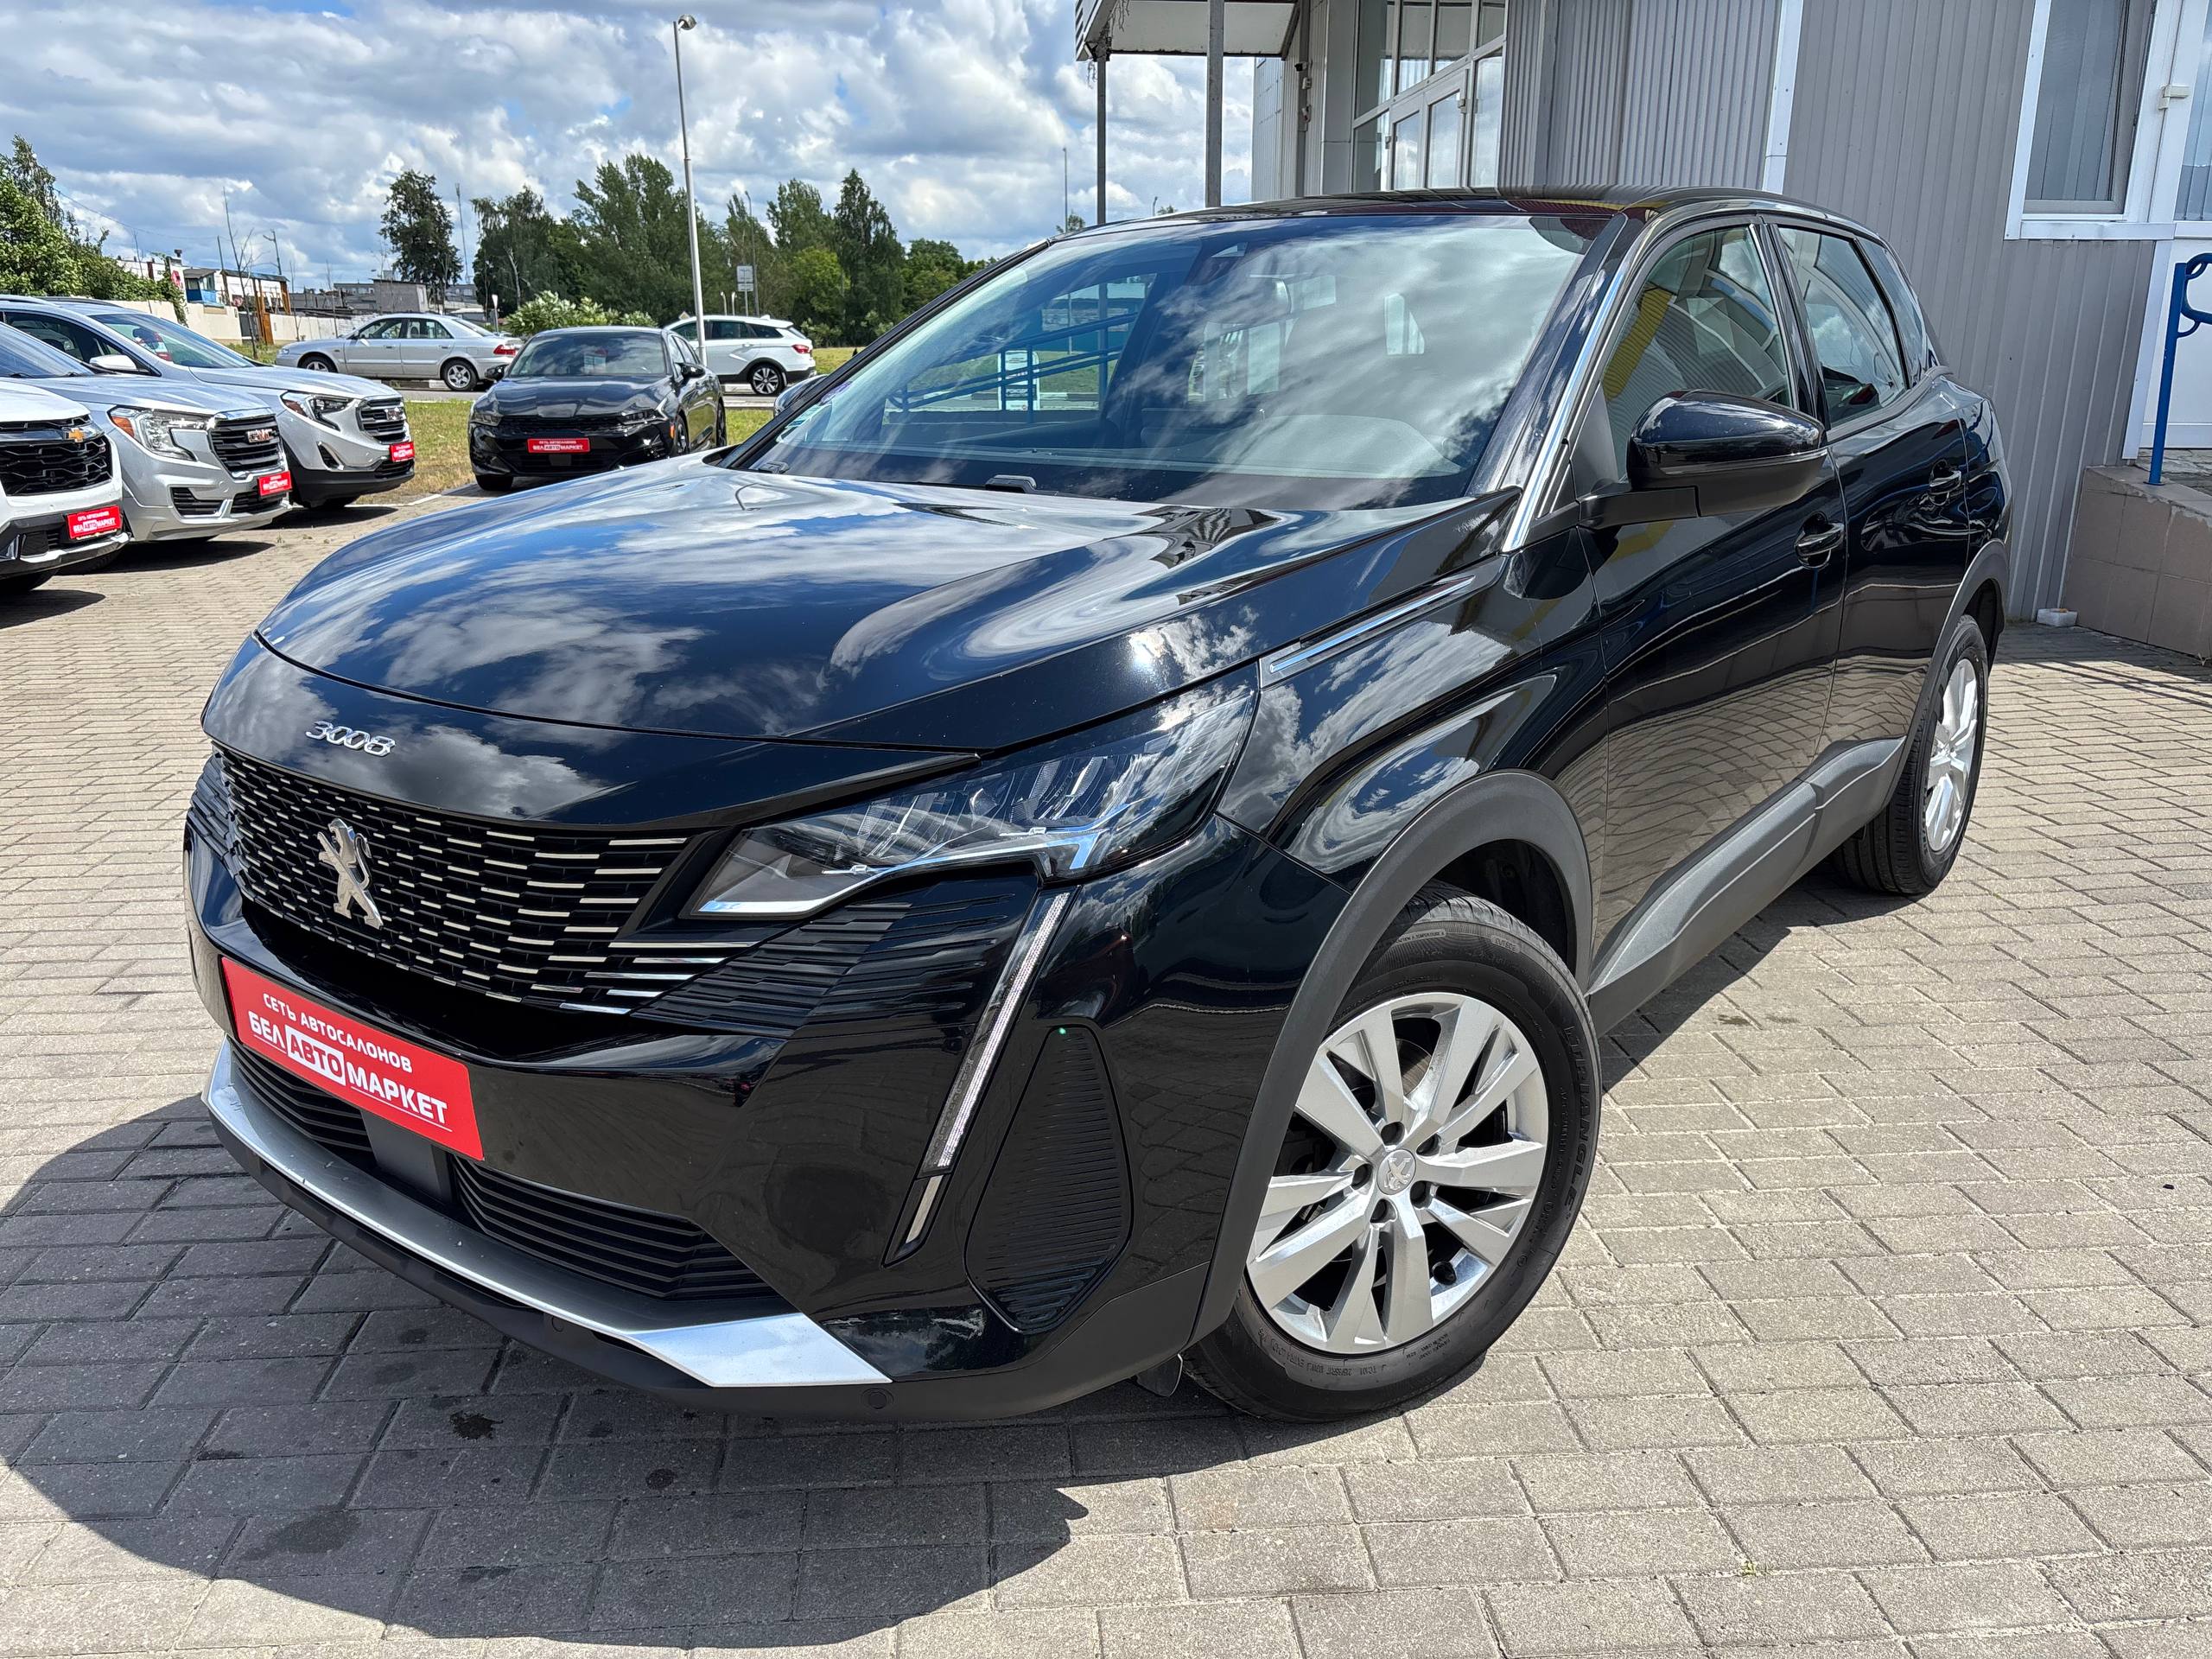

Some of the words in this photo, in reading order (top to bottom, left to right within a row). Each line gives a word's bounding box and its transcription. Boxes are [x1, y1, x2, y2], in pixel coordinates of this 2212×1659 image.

[306, 721, 396, 757] 3008
[263, 993, 296, 1021] СЕТЬ
[300, 1012, 412, 1073] АВТОСАЛОНОВ
